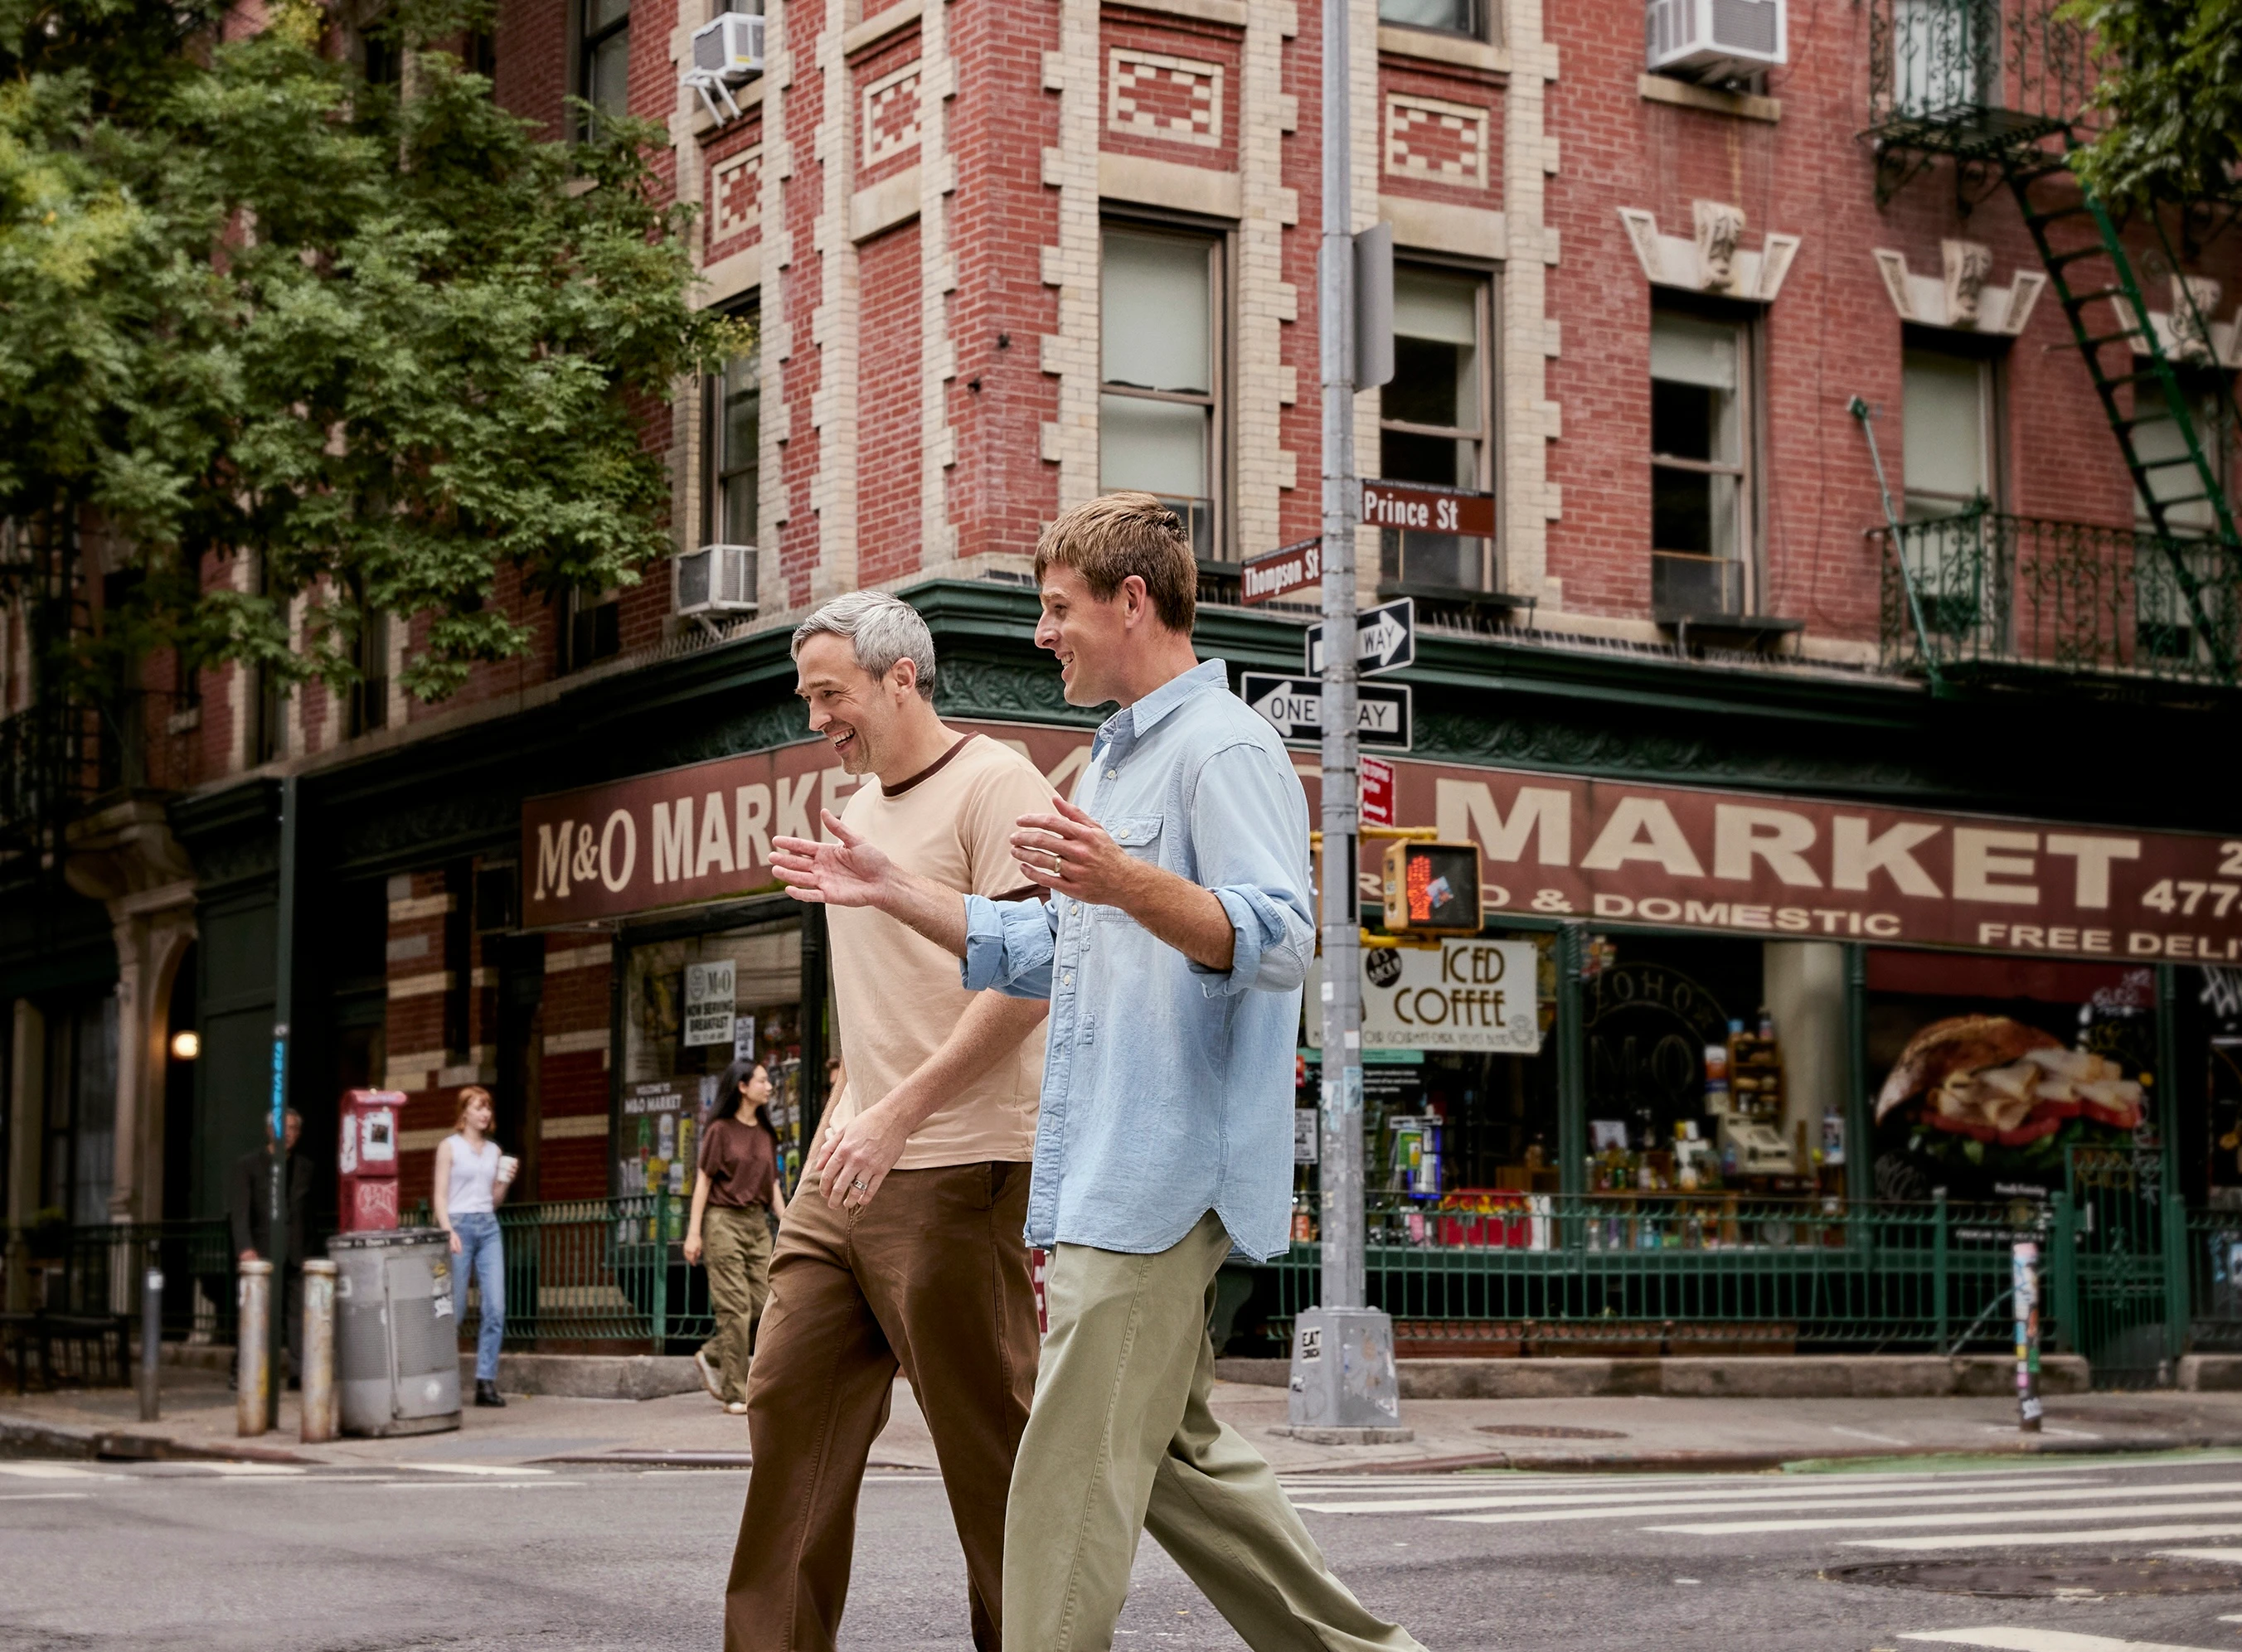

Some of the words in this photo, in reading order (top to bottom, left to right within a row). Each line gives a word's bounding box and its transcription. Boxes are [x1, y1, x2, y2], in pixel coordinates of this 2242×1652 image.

[1364, 490, 1429, 527] Prince
[1436, 498, 1458, 530] St
[1244, 559, 1303, 598] Thompson
[1304, 548, 1320, 580] St
[1363, 624, 1396, 653] WAY
[1270, 697, 1317, 722] ONE
[1357, 705, 1388, 726] AY
[533, 808, 637, 902] M&O
[652, 764, 879, 884] MARKE
[1435, 778, 2141, 908] MARKET
[1594, 893, 1901, 937] DOMESTIC
[2142, 878, 2242, 918] 477
[1979, 923, 2113, 953] FREE
[1442, 945, 1505, 984] ICED
[1394, 987, 1506, 1028] COFFEE
[1303, 1330, 1320, 1347] EAT
